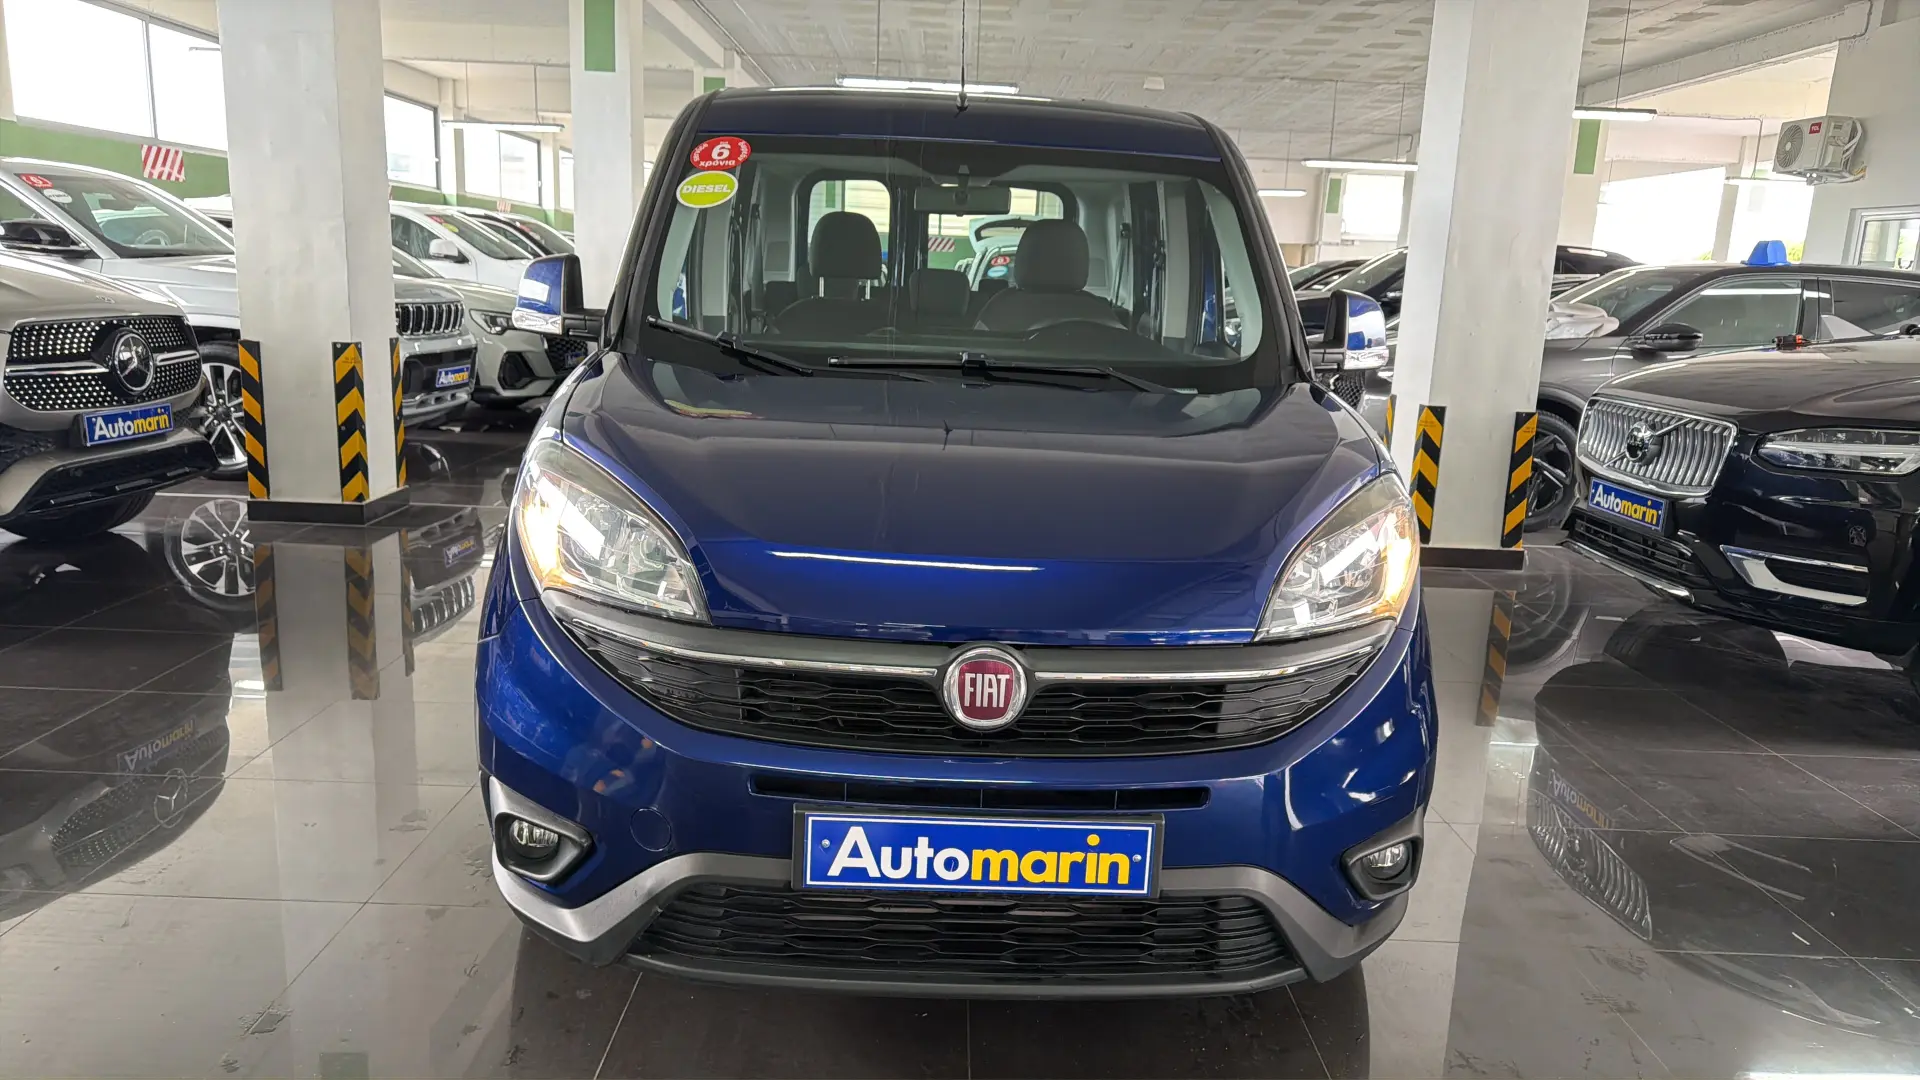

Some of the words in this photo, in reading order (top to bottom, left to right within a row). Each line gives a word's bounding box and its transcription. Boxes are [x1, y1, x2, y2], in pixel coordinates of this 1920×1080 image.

[711, 142, 731, 160] 6
[682, 184, 731, 194] DIESEL
[94, 408, 169, 440] Automarin
[1593, 484, 1658, 525] Automarin
[964, 672, 1010, 708] FIAT
[827, 826, 1130, 885] Automarin
